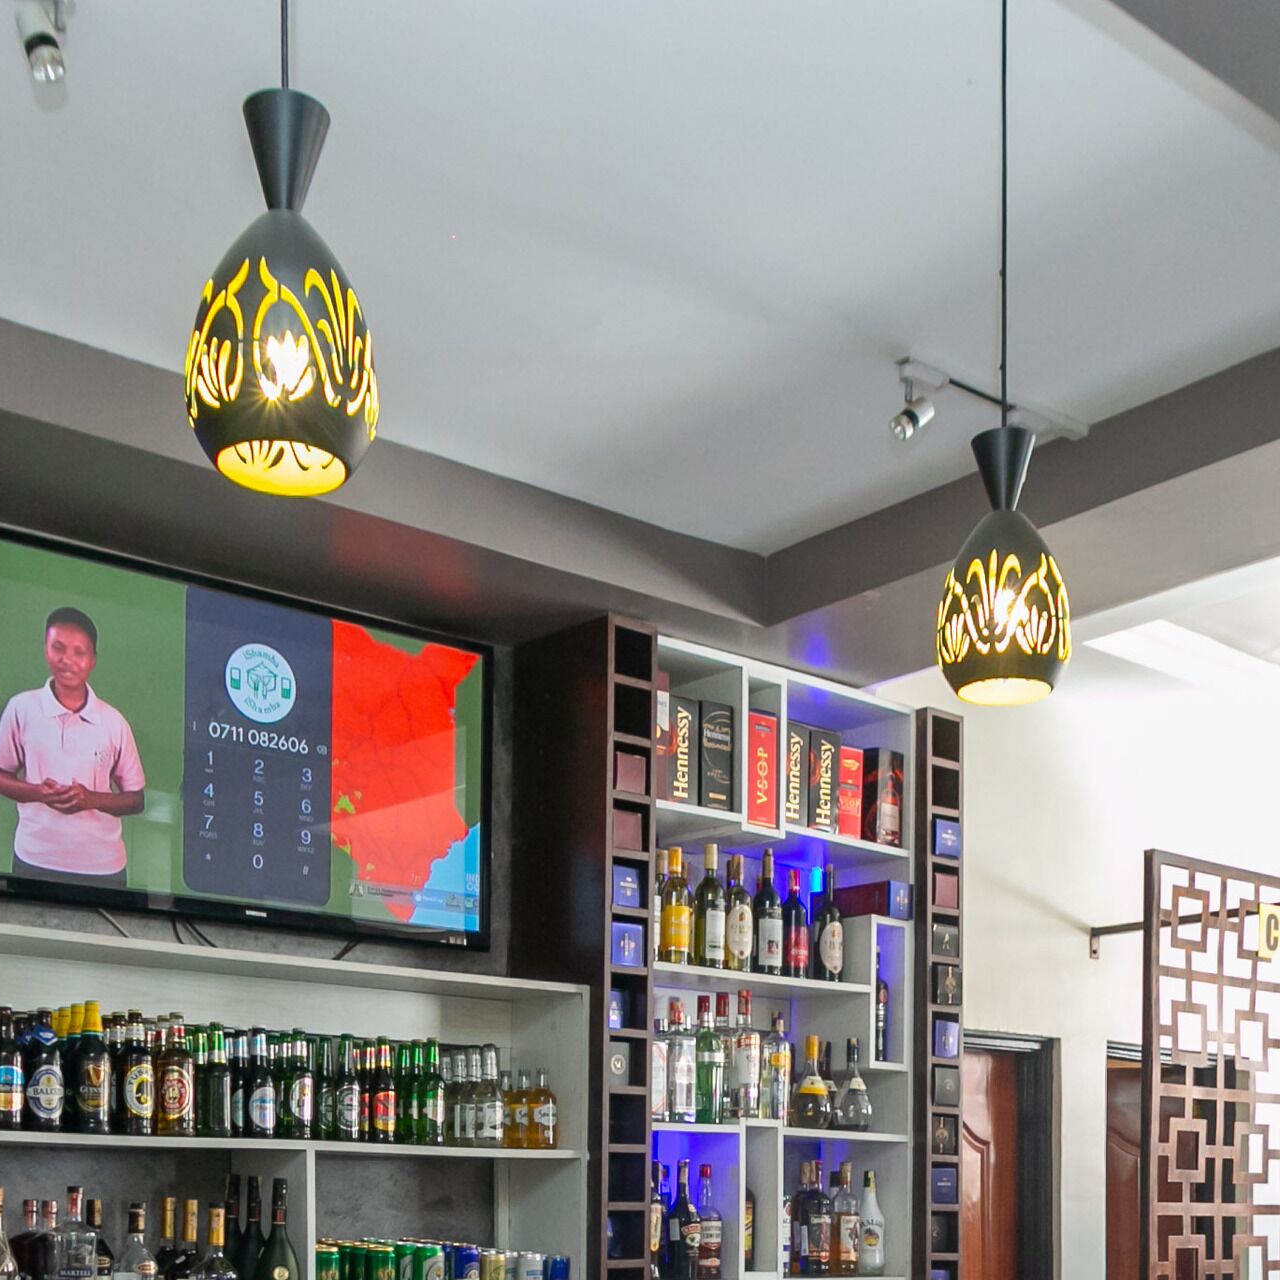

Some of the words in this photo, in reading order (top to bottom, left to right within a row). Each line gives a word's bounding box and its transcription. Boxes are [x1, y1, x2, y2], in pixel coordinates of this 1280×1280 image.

[209, 721, 244, 743] 0711
[248, 729, 309, 754] 082606
[207, 751, 214, 766] 1
[673, 705, 692, 799] Hennessy
[253, 759, 264, 775] 2
[301, 767, 312, 783] 3
[785, 731, 804, 820] Hennessy
[815, 739, 835, 826] Hennessy
[203, 783, 215, 798] 4
[253, 790, 264, 806] 5
[301, 798, 312, 815] 6
[204, 814, 215, 830] 7
[252, 822, 264, 838] 8
[300, 829, 312, 845] 9
[252, 854, 264, 870] 0
